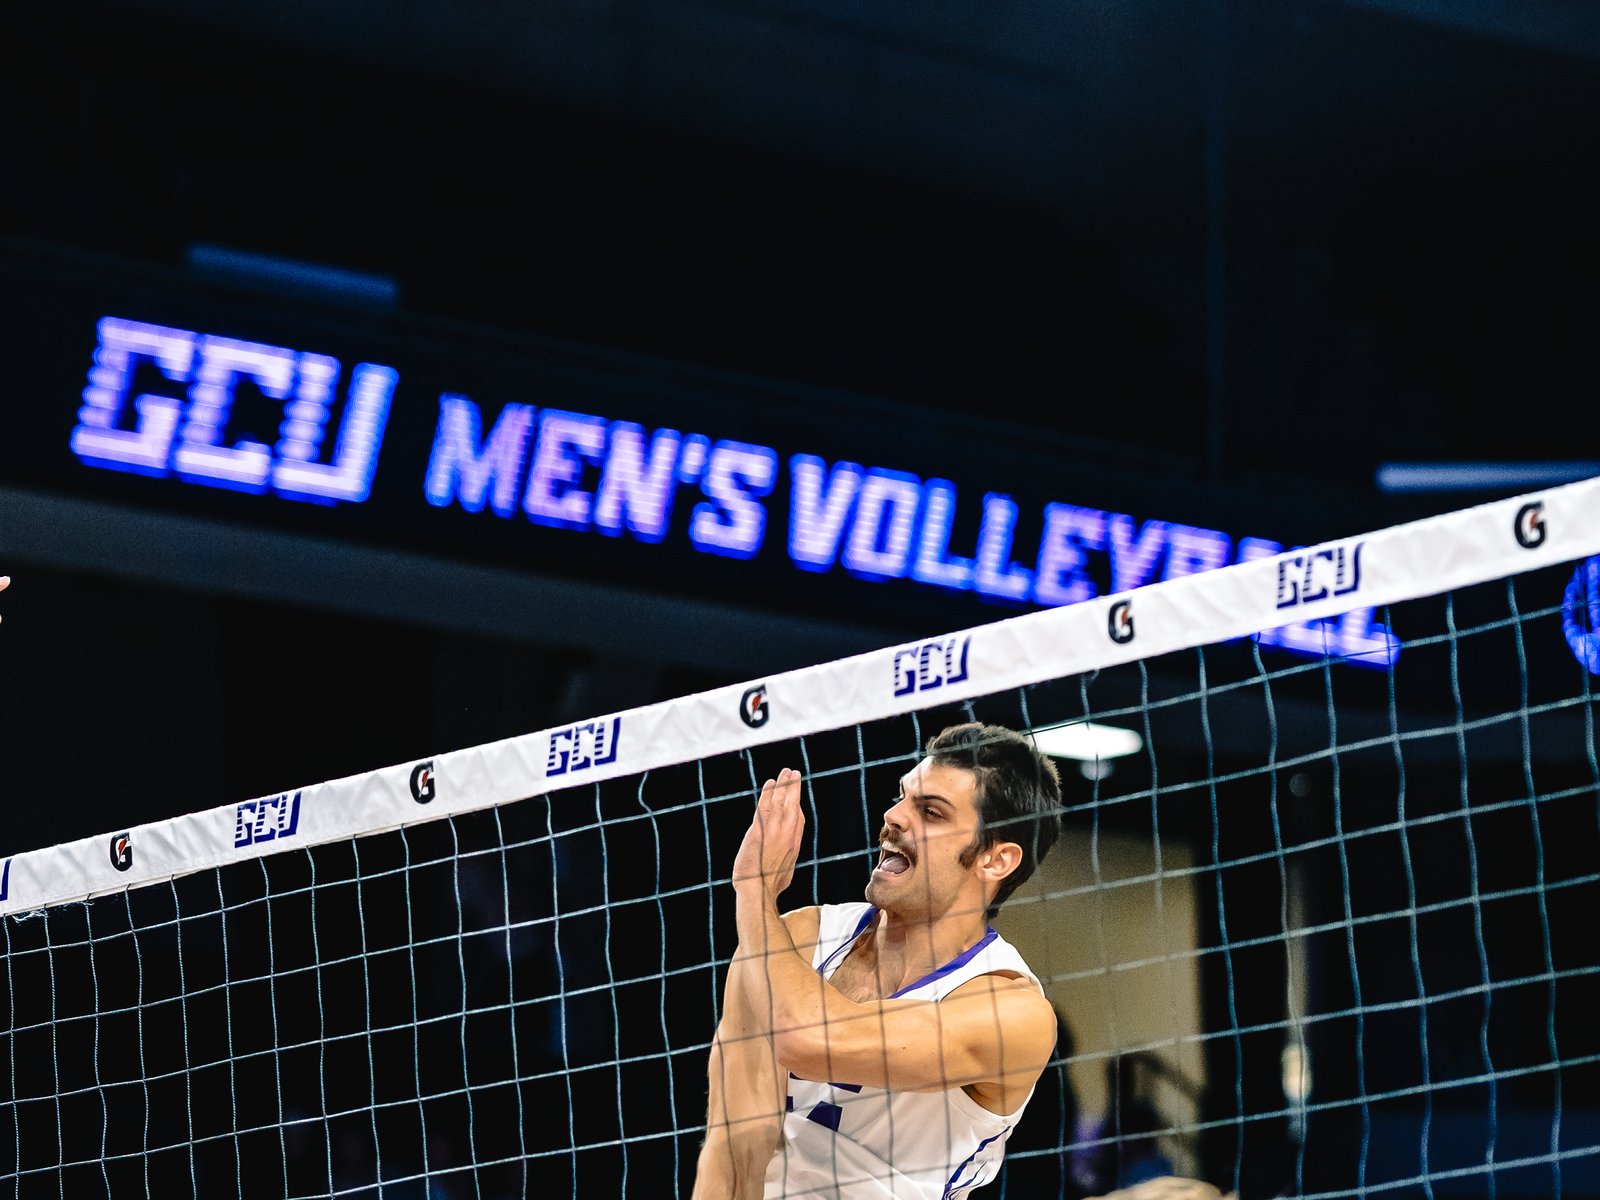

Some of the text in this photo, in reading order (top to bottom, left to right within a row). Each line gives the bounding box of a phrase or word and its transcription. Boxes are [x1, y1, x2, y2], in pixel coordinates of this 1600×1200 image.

[71, 316, 1400, 669] GCU MEN'S VOLLEYL
[1276, 541, 1366, 609] GCU
[894, 635, 972, 697] GCU
[546, 717, 622, 777] GCU
[234, 790, 302, 849] GCU
